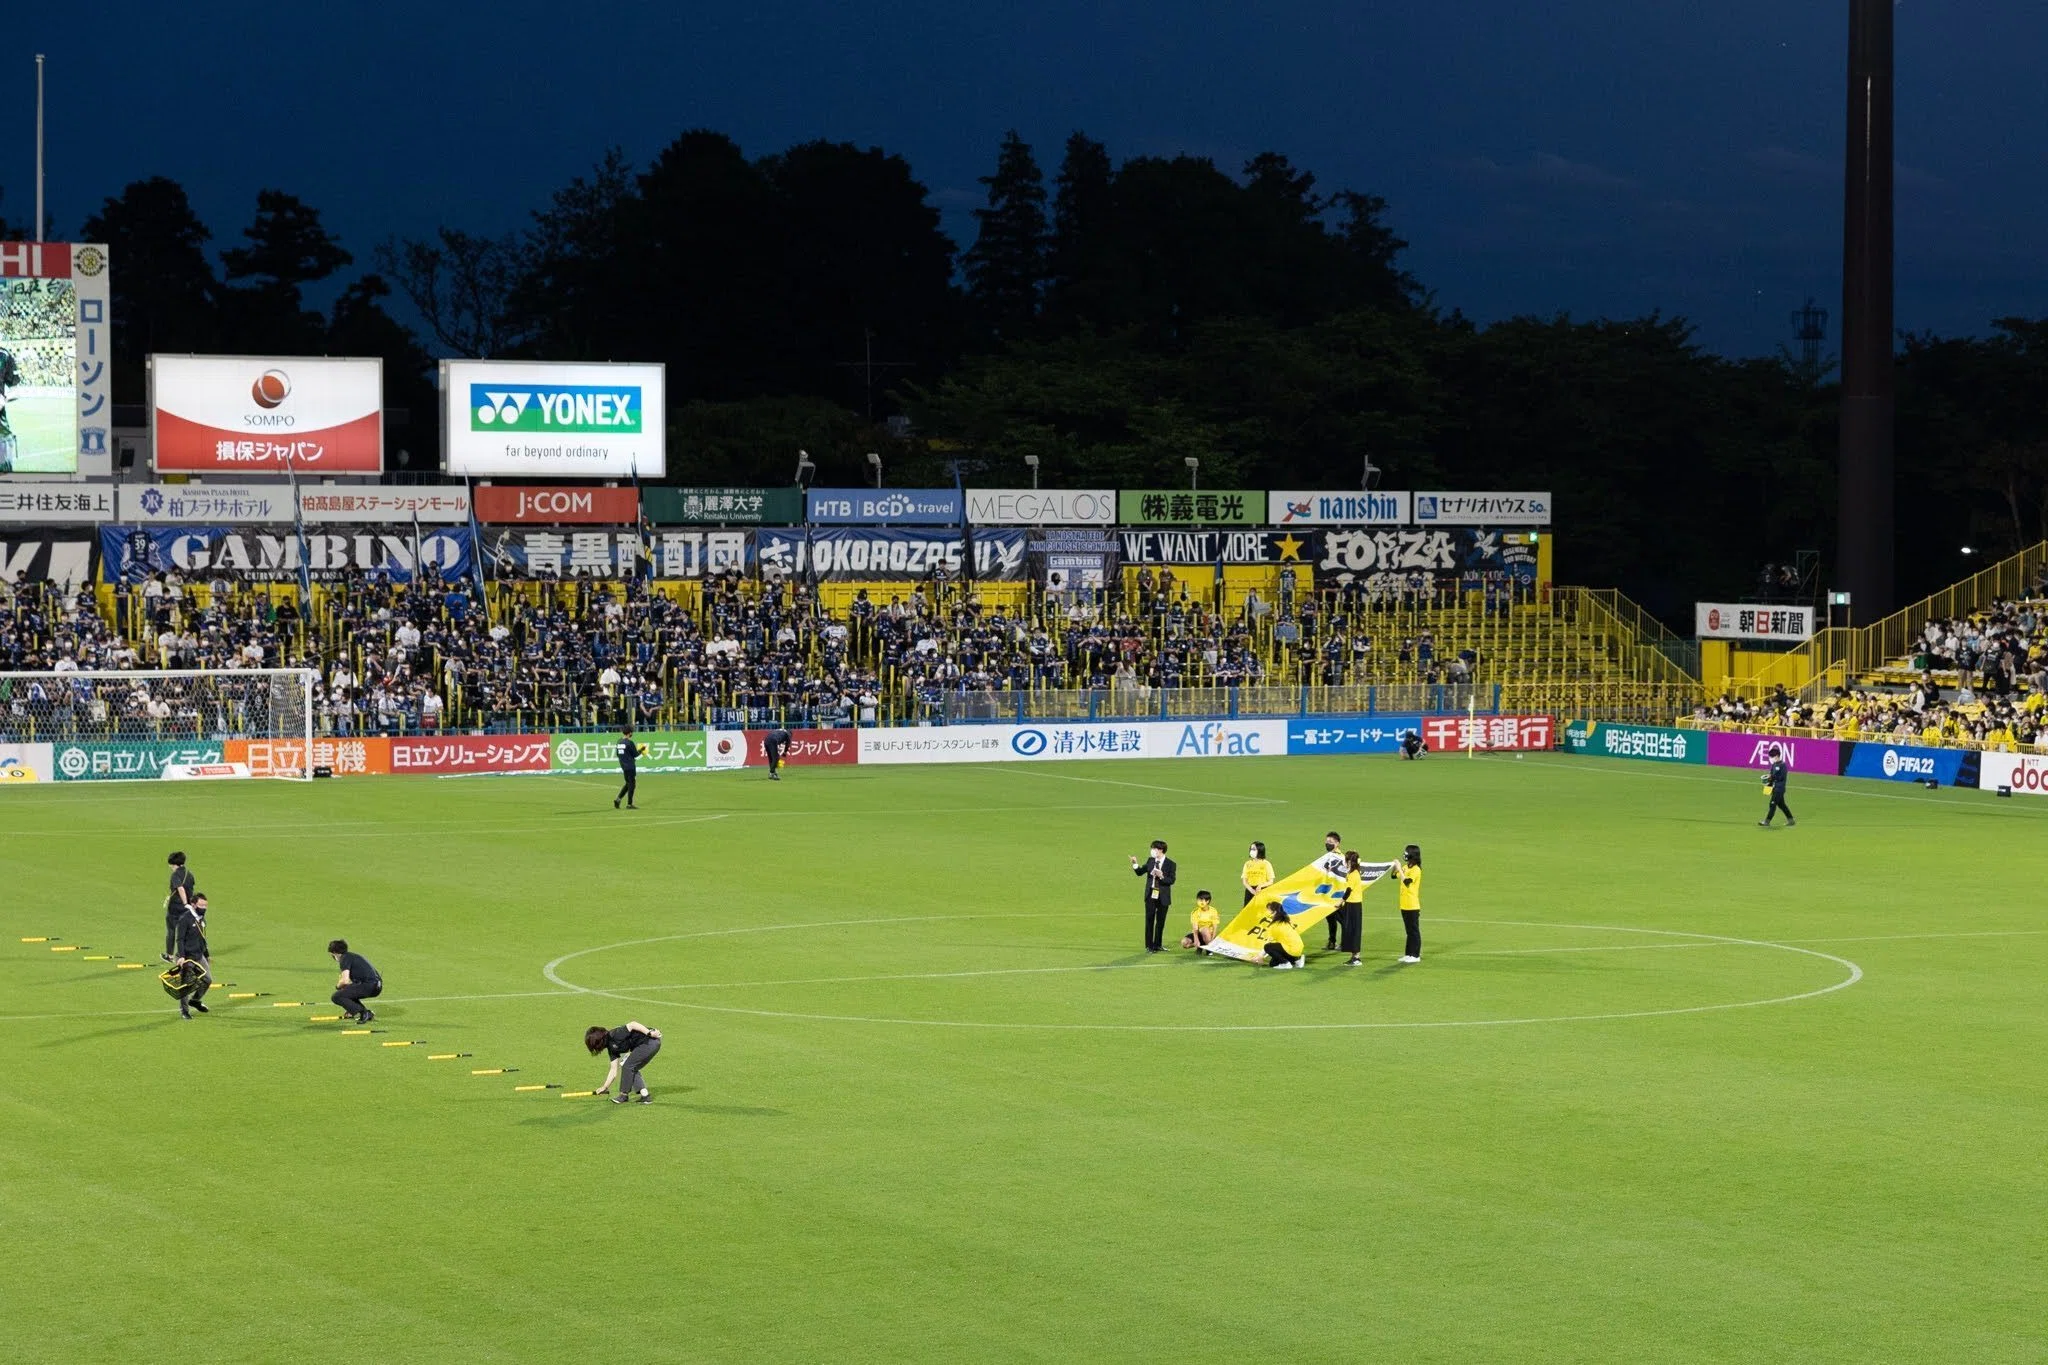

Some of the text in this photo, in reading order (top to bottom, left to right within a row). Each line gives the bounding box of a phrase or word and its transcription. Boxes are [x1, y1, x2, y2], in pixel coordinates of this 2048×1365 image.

[80, 299, 105, 417] ローソン
[243, 414, 295, 427] SOMPO
[536, 393, 632, 425] YONEX
[216, 440, 323, 462] 損保ジャパン
[505, 445, 609, 460] far beyond ordinary
[0, 493, 110, 512] 三井住友海上
[168, 497, 272, 518] 柏プラザホテル
[516, 491, 592, 518] J:COM
[815, 501, 851, 516] HTB
[863, 501, 953, 517] BCD travel
[970, 494, 1111, 520] MEGALOS
[1141, 494, 1244, 521] (株)義電光
[1320, 494, 1397, 520] nanshin
[1440, 498, 1525, 513] セナリオハウス
[730, 512, 762, 521] University
[171, 535, 460, 570] GAMBINO
[1125, 534, 1153, 562] WE
[1159, 534, 1209, 562] WANT
[1320, 530, 1456, 571] FORZA
[244, 571, 283, 581] CURVA
[1739, 610, 1804, 635] 朝日新聞
[1053, 730, 1141, 753] 清水建設
[1427, 719, 1549, 749] 千葉銀行
[1605, 729, 1687, 759] 明治安田生命
[92, 750, 221, 772] 日立ハイテク
[247, 741, 367, 774] 日立建機
[393, 742, 550, 767] 日立ソリューションズ
[583, 740, 703, 762] 日立ステムズ
[1899, 756, 1935, 774] FIFA 22
